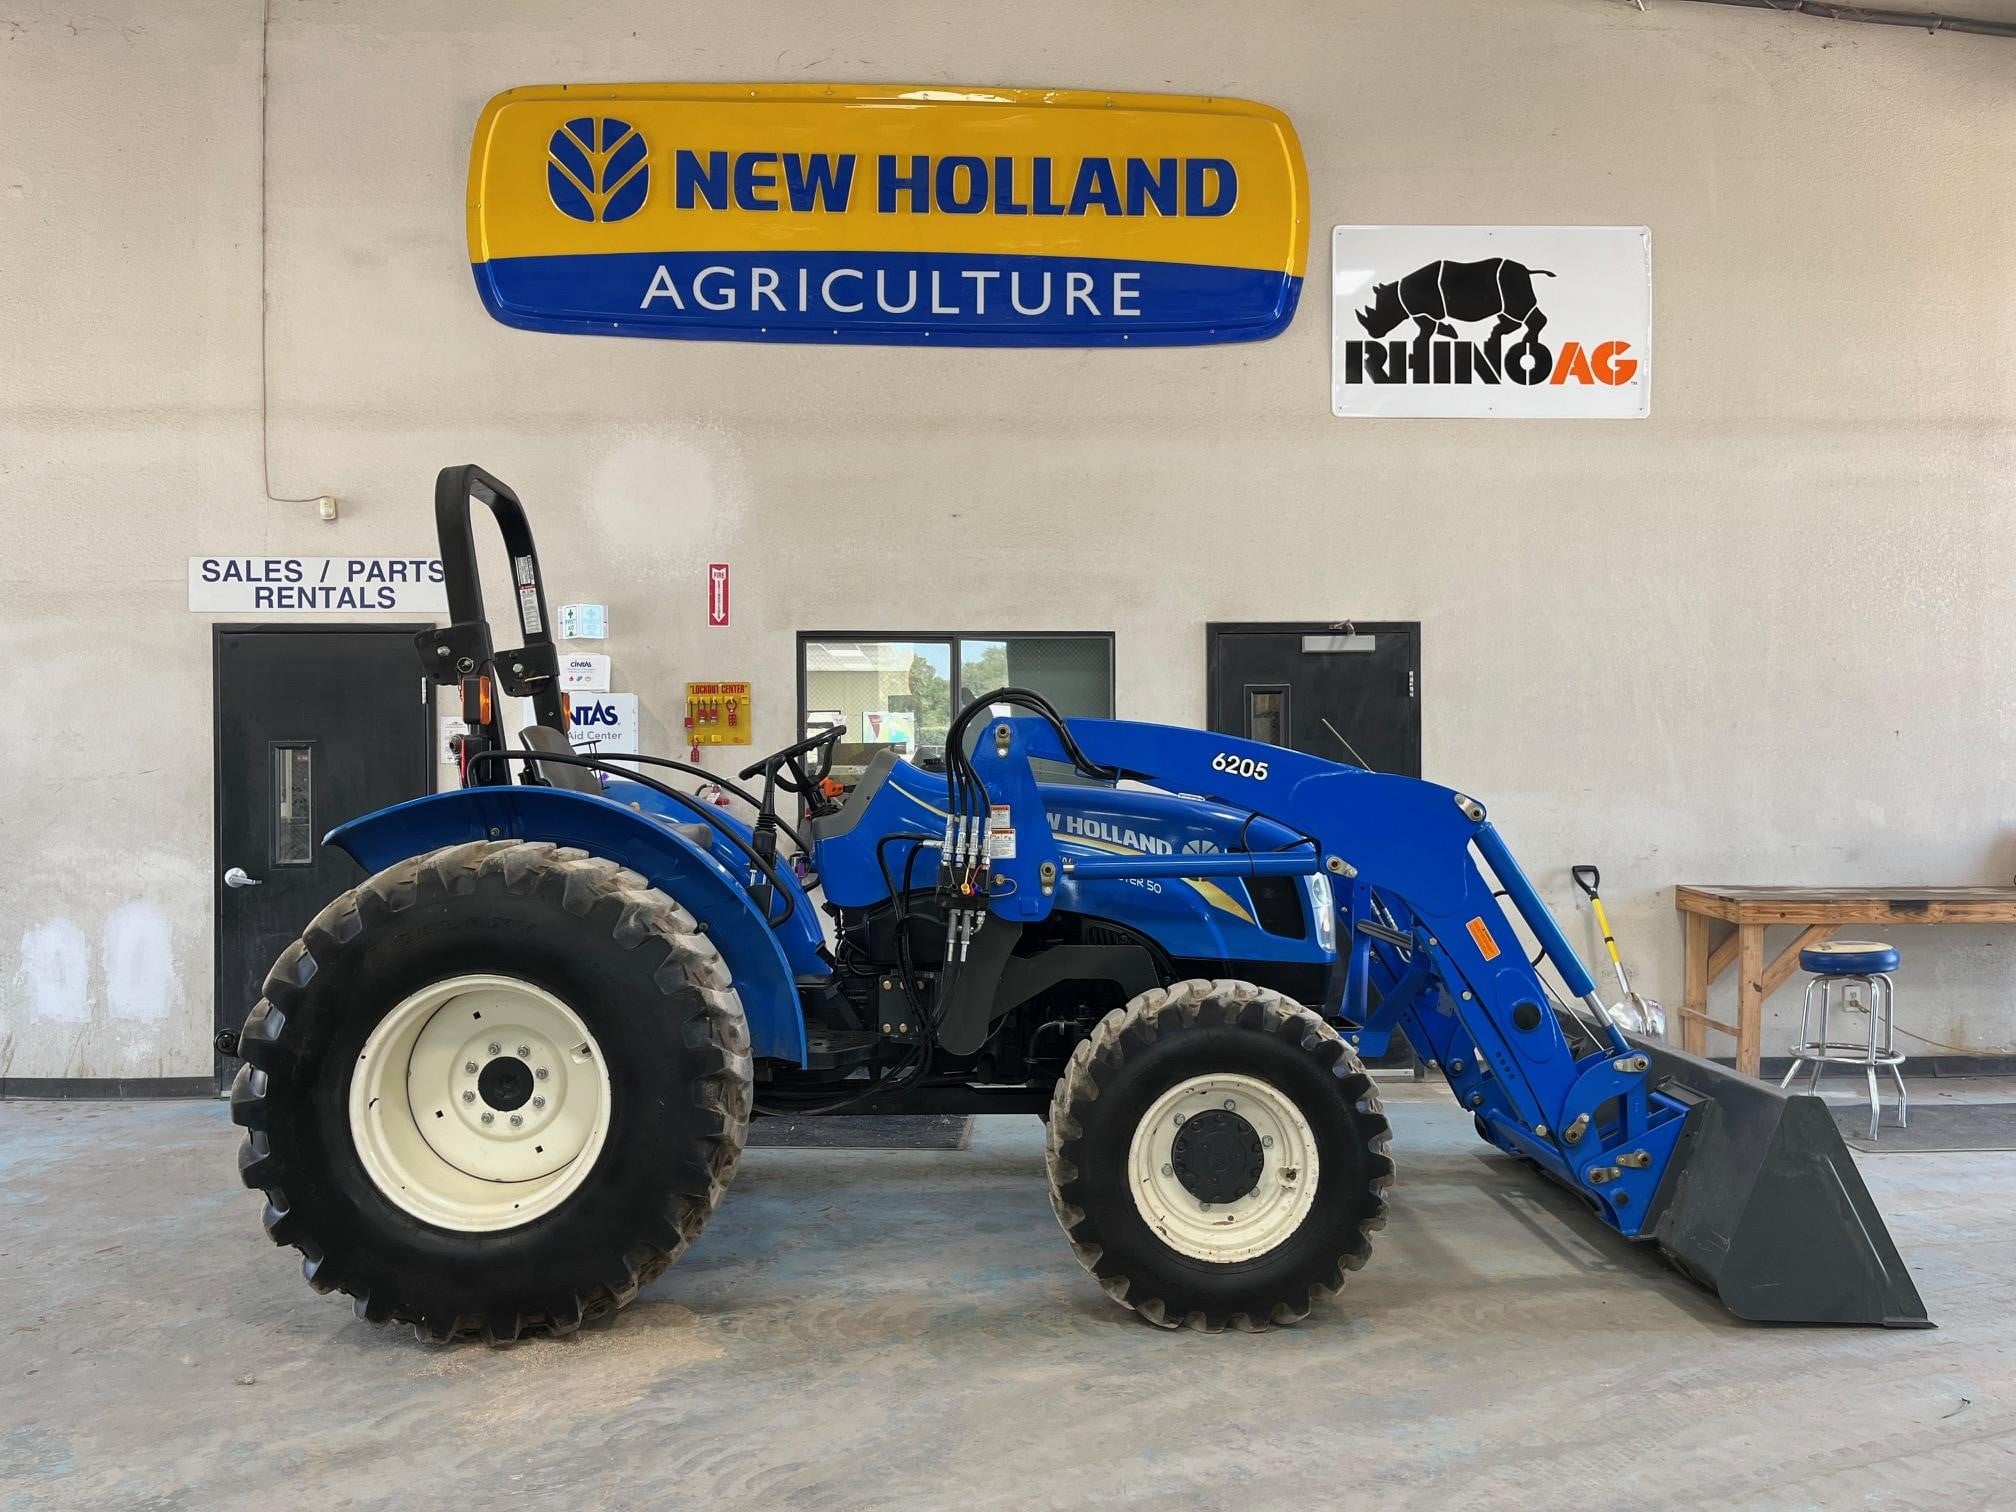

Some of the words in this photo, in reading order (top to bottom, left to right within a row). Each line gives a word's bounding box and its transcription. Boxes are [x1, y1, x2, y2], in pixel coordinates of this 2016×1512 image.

[675, 150, 857, 214] NEW
[876, 154, 1238, 218] HOLLAND
[639, 264, 1142, 317] AGRICULTURE
[201, 559, 304, 583] SALES
[319, 559, 331, 583] /
[347, 559, 446, 583] PARTS
[713, 571, 725, 579] FIRE
[254, 586, 397, 610] RENTALS
[587, 731, 622, 740] Center
[1212, 752, 1269, 781] 6205
[1066, 815, 1173, 855] HOLLAND
[1147, 879, 1162, 895] 50
